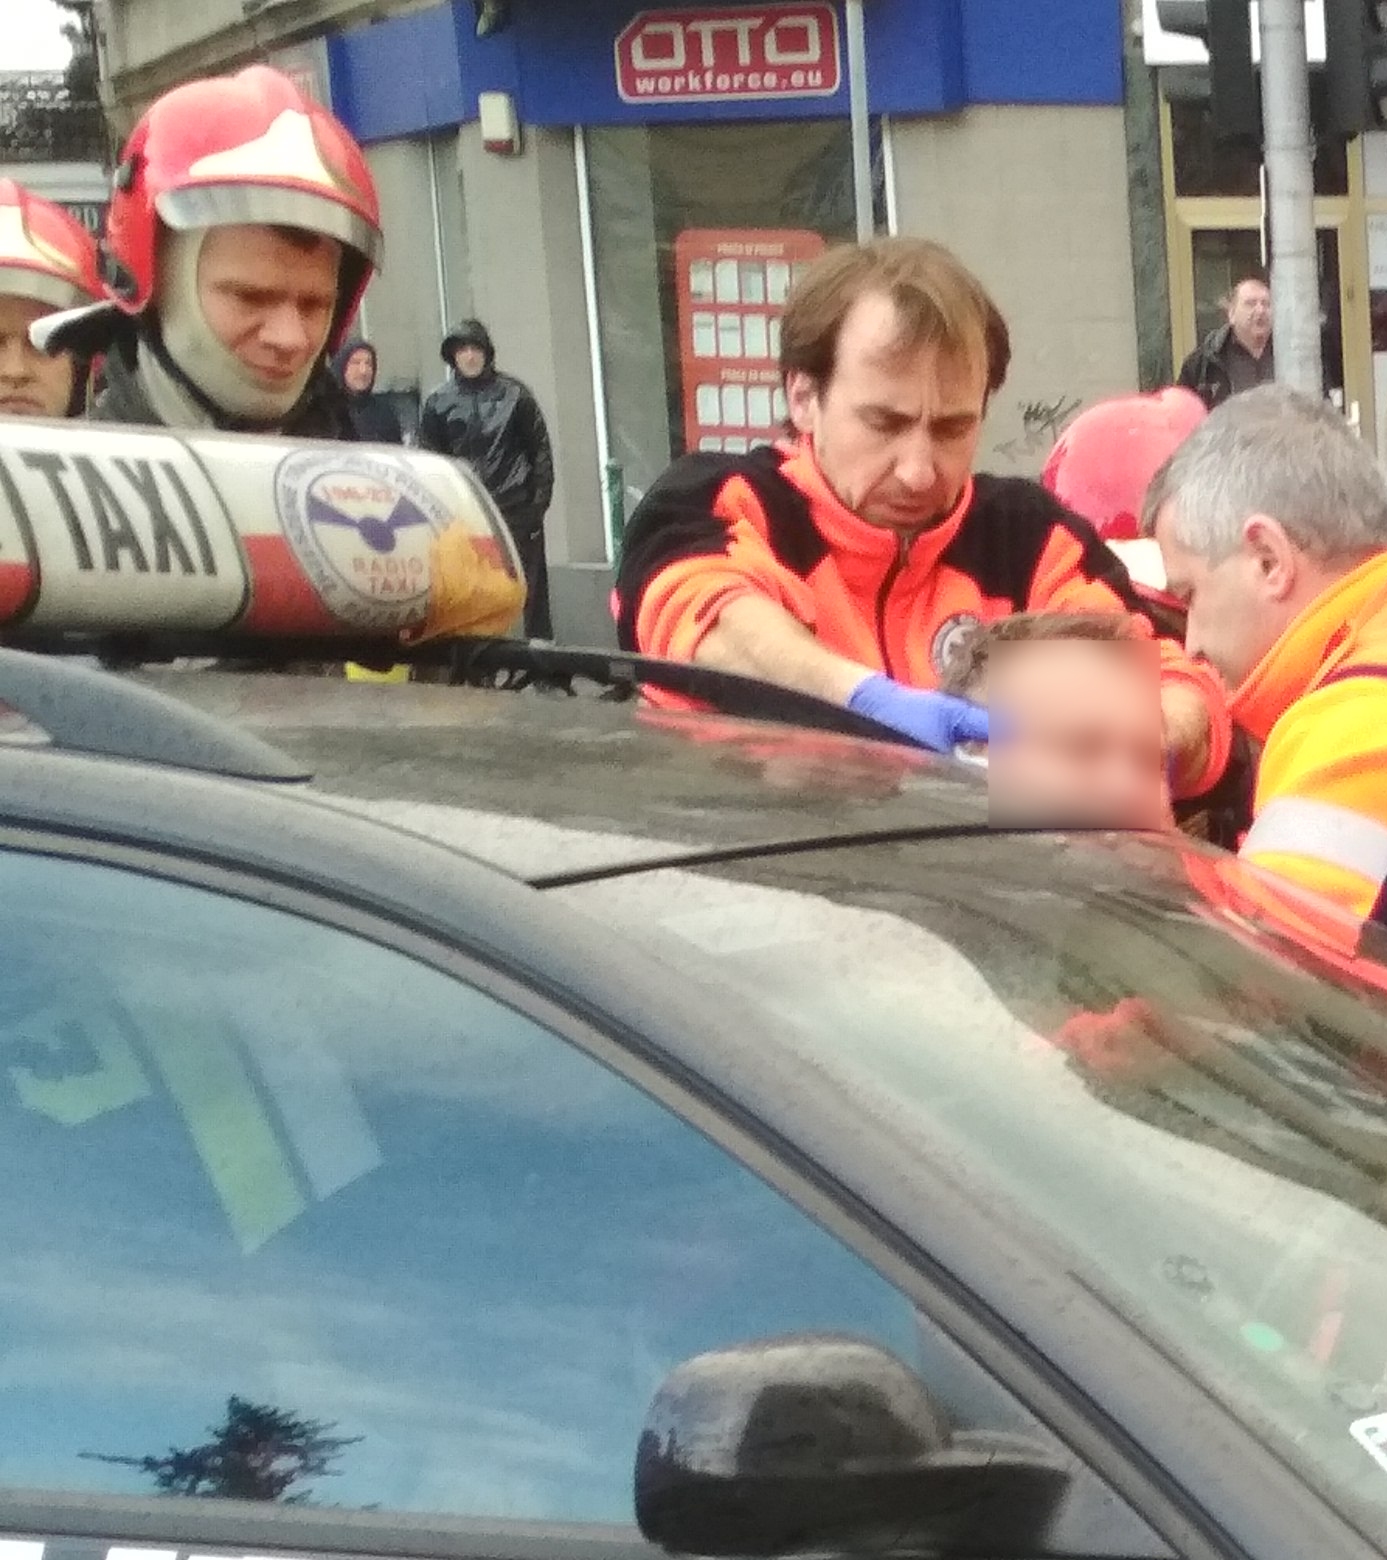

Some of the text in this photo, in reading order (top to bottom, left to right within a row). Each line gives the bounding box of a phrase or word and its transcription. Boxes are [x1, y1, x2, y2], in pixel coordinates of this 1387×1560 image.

[631, 15, 821, 70] OTTO
[635, 69, 823, 94] workforce.eu
[17, 451, 218, 577] TAXI
[352, 556, 424, 576] RADIO
[367, 575, 418, 595] TAXI
